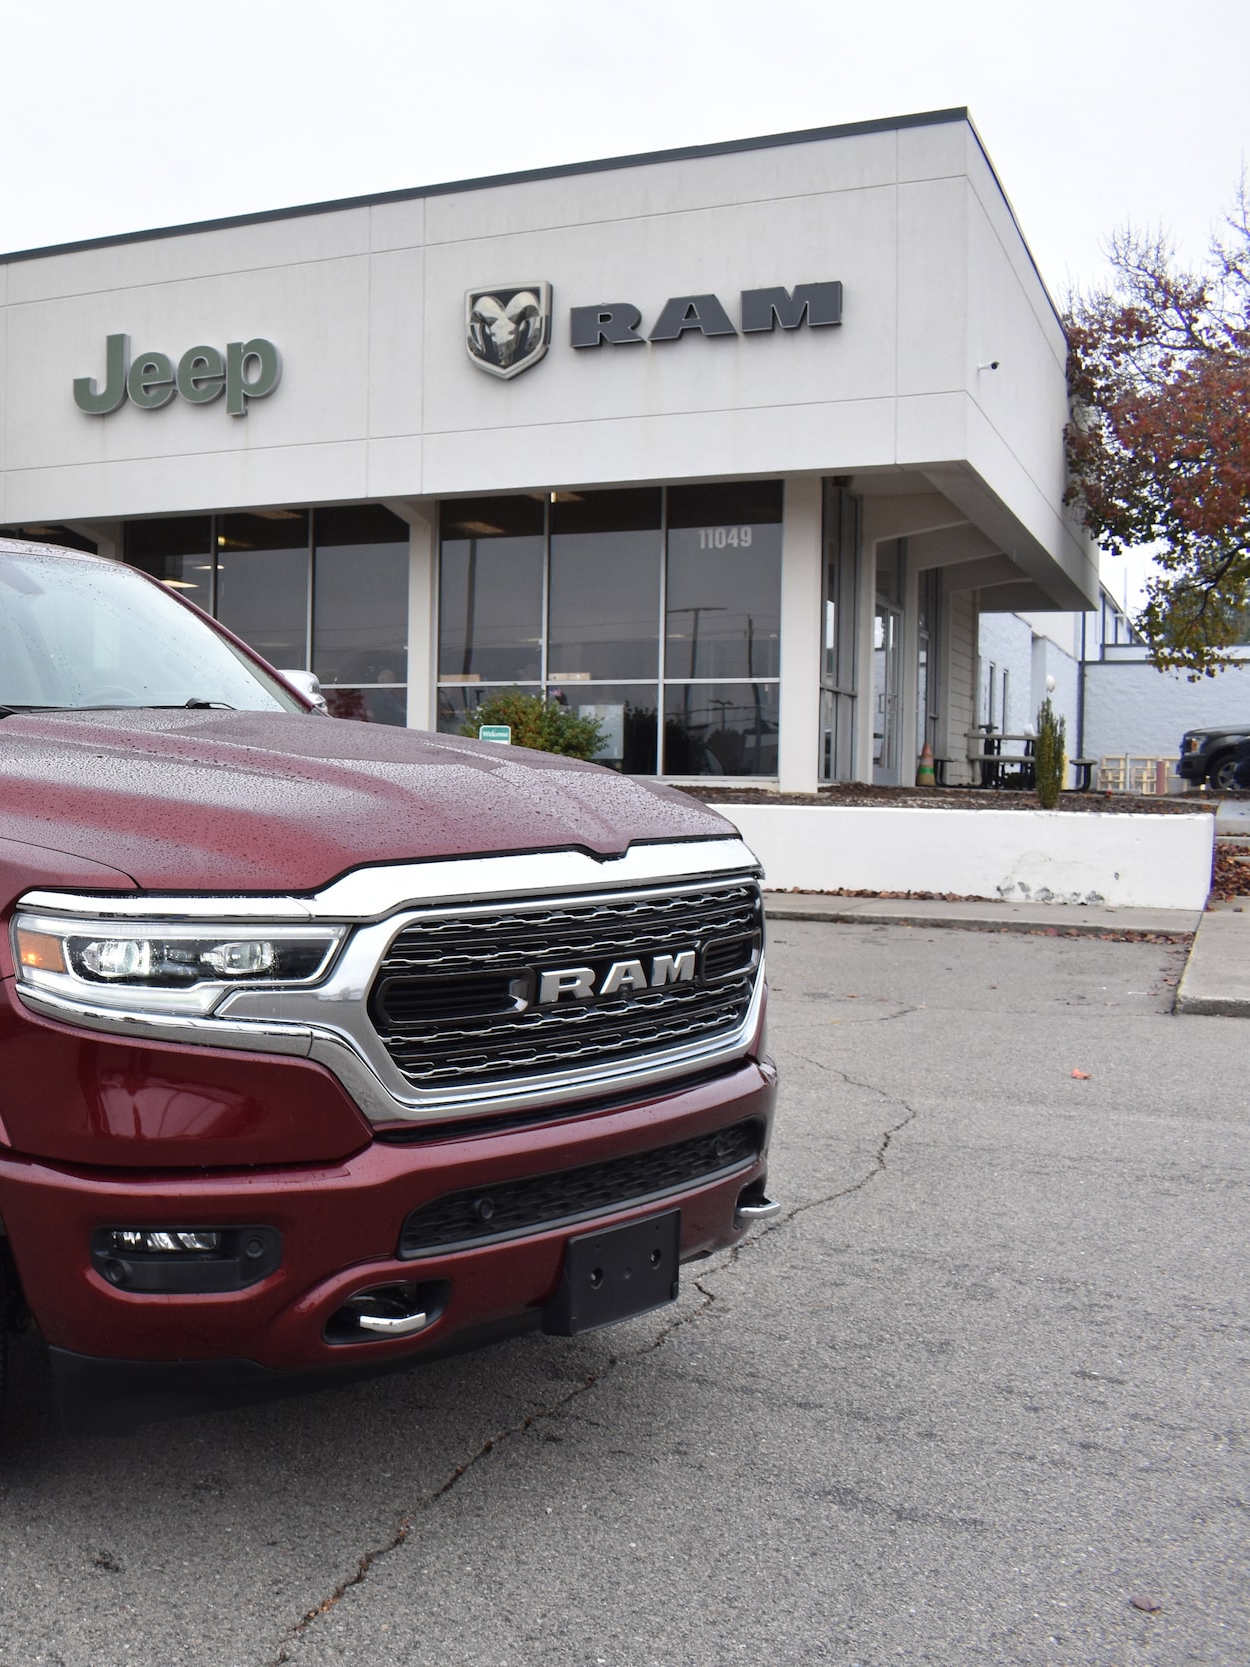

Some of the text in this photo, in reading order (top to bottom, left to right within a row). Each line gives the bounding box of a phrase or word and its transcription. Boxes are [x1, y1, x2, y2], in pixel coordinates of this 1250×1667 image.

[570, 281, 843, 349] RAM
[73, 333, 282, 416] Jeep
[699, 526, 752, 549] 11049
[539, 950, 696, 1004] RAM
